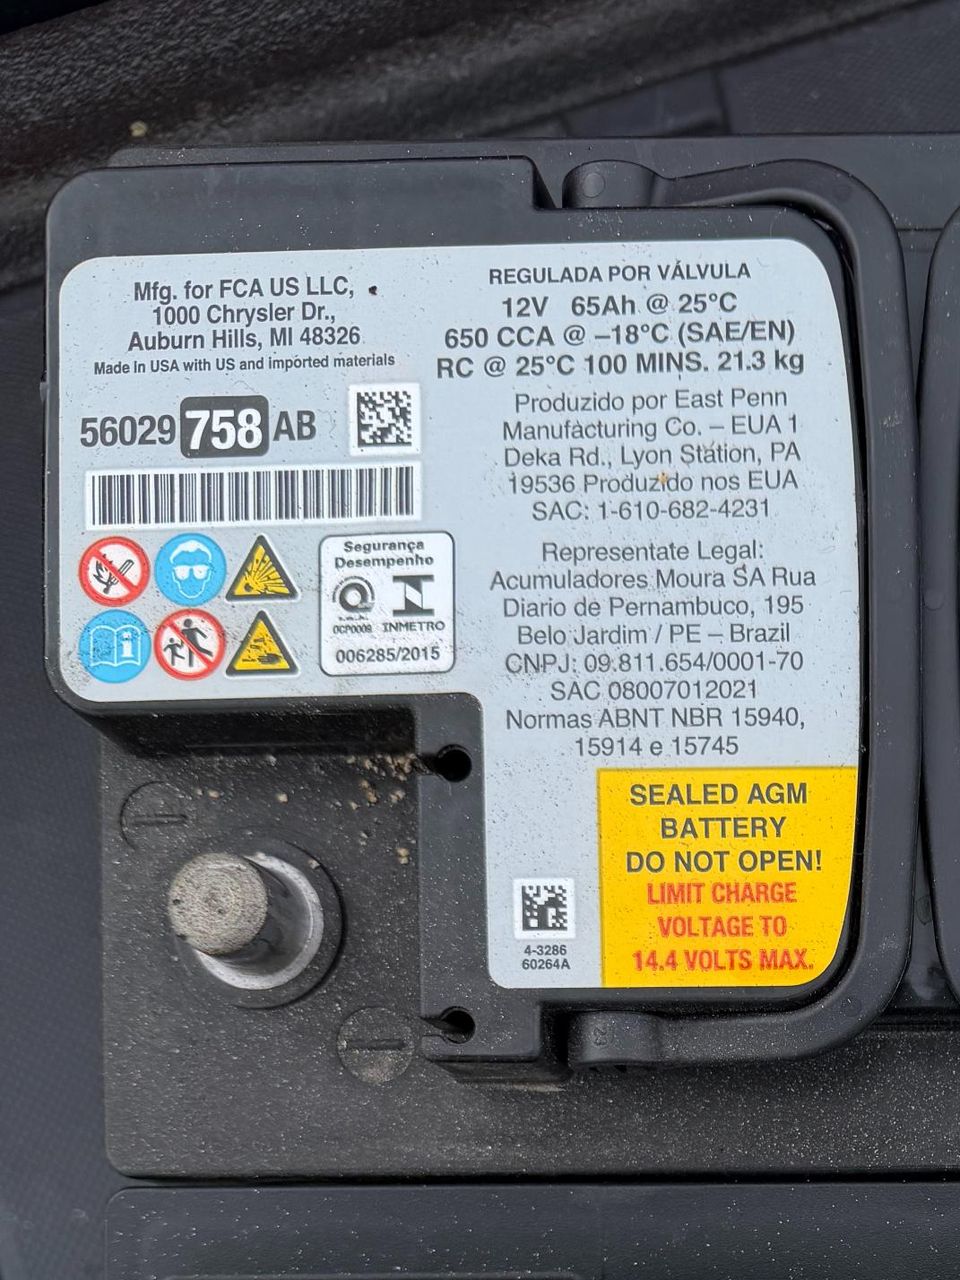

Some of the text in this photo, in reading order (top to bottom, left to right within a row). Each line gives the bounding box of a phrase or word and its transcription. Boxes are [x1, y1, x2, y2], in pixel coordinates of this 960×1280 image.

[489, 259, 751, 286] REGULADA POR VÁLVULA
[134, 276, 354, 303] Mfg. for FCA US LLC,
[153, 302, 335, 326] 1000 Chrysler Dr.,
[502, 296, 548, 318] 12V
[572, 294, 635, 316] 65Ah
[646, 294, 669, 315] @
[128, 326, 360, 350] Auburn Hills, MI 48326
[445, 328, 489, 348] 650
[497, 326, 554, 347] CCA
[563, 326, 586, 345] @
[678, 319, 795, 347] (SAE/EN)
[94, 354, 395, 374] Made in USA with US and imported materials
[437, 358, 474, 378] RC
[484, 357, 506, 377] @
[584, 354, 627, 373] 100
[636, 352, 709, 373] MINS.
[718, 351, 765, 371] 21.3
[774, 350, 804, 373] kg
[515, 388, 788, 414] Produzido por East Penn
[532, 499, 770, 521] SAC: 1-610-682-4231
[335, 554, 434, 570] Desempenho
[542, 540, 763, 565] Representate Legal:
[382, 621, 445, 632] INMETRO
[336, 647, 440, 663] 006285/2015
[505, 652, 804, 674] CNPJ: 09.811.654/0001-70
[551, 679, 757, 701] SAC 08007012021
[630, 783, 807, 805] SEALED AGM
[661, 817, 787, 839] BATTERY
[626, 850, 822, 873] DO NOT OPEN!
[648, 882, 797, 904] LIMIT CHARGE
[658, 916, 787, 937] VOLTAGE TO
[523, 945, 567, 956] 4-3286
[633, 948, 814, 971] 14.4 VOLTS MAX.
[522, 958, 570, 970] 60264A
